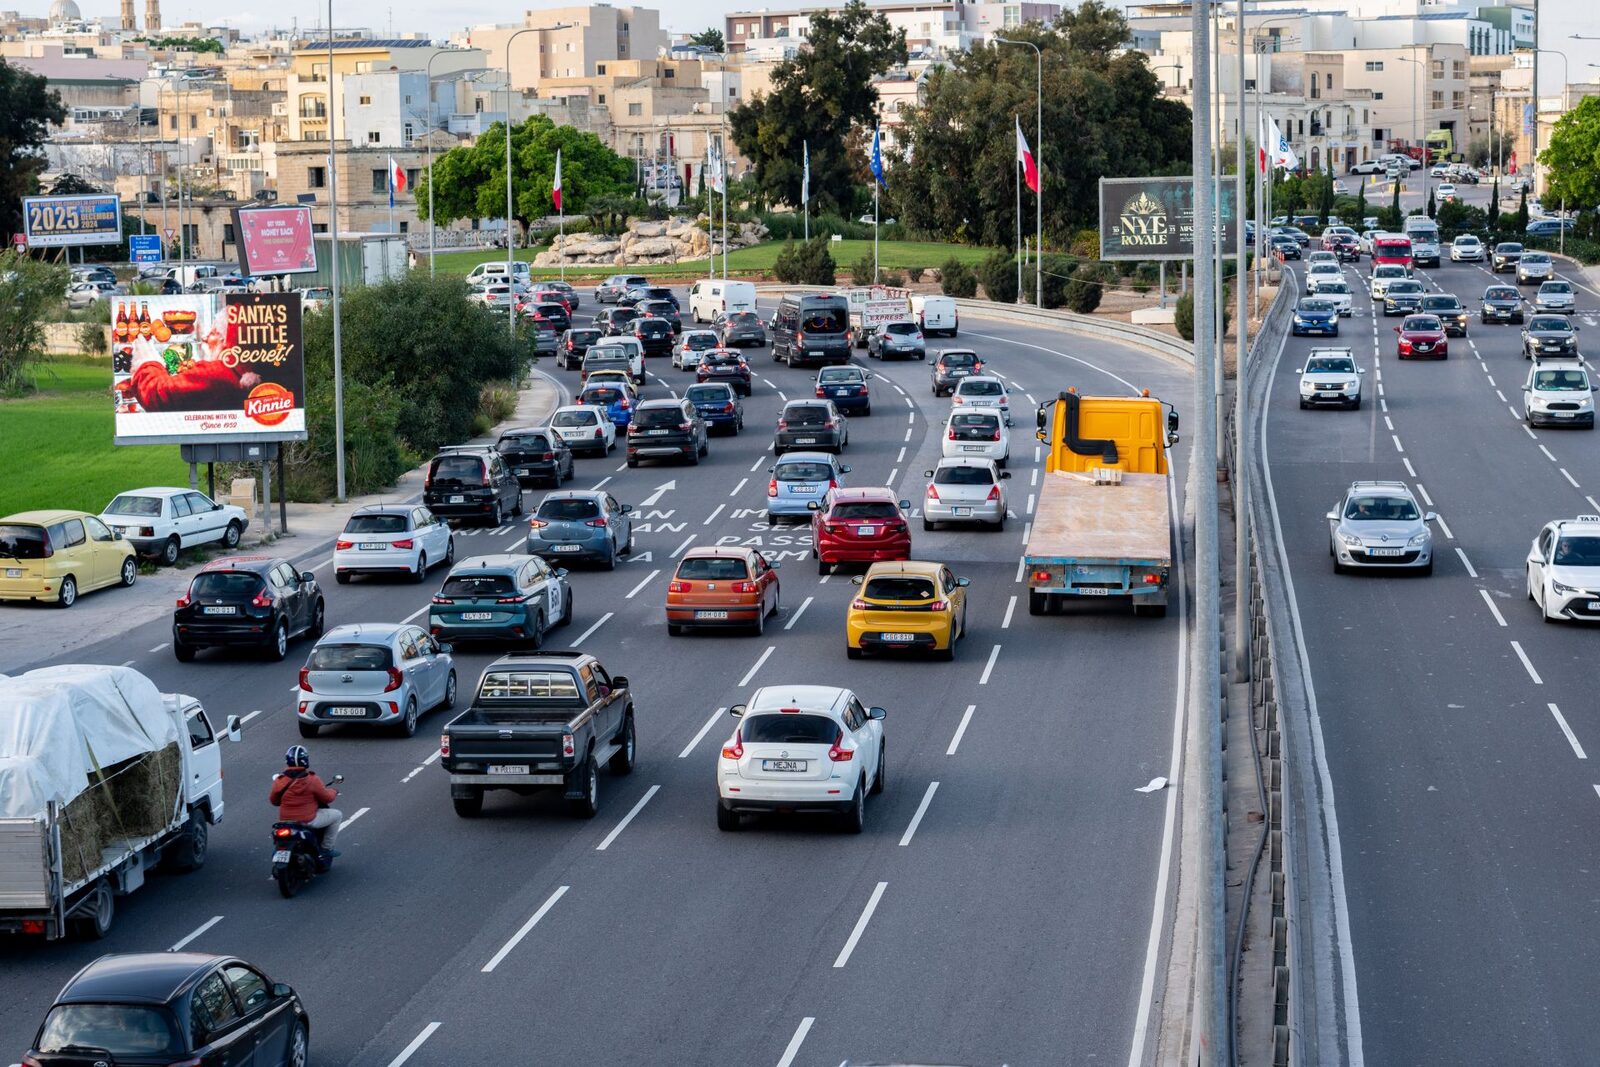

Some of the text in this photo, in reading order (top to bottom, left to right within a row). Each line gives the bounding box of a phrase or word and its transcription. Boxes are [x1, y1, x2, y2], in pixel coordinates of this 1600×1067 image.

[30, 206, 80, 230] 2025
[80, 212, 114, 220] DECEMBER
[80, 220, 98, 228] 2024
[261, 227, 294, 236] MONEY BACK
[1120, 216, 1168, 234] NYE
[1121, 235, 1168, 246] ROYALE
[228, 304, 287, 324] SANTA'S
[238, 324, 288, 344] LITTLE
[218, 344, 294, 368] Secret!
[248, 399, 292, 415] Kinnie
